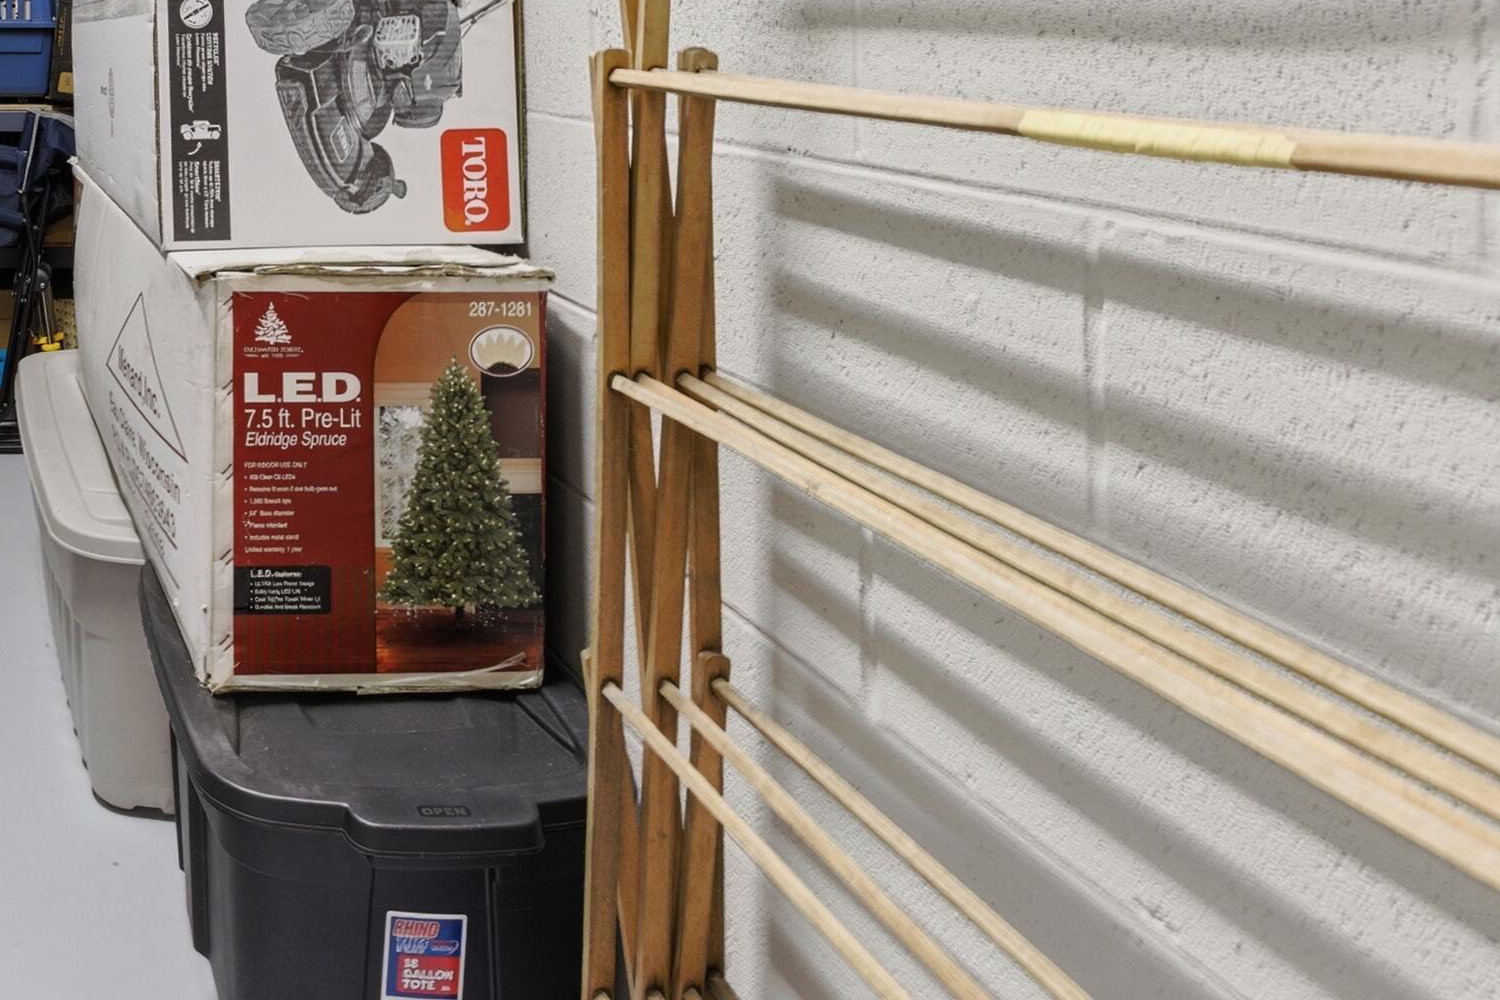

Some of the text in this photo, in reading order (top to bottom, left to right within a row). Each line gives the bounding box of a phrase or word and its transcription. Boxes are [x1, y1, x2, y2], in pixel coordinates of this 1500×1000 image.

[462, 136, 489, 223] TORO
[469, 301, 532, 317] 287-1281
[244, 372, 361, 403] L.E.D.
[244, 408, 361, 428] 7.5 ft. Pre-Lit
[245, 431, 347, 450] Eldridge Spruce
[421, 807, 467, 816] OPEN
[394, 920, 438, 937] RHINO
[403, 969, 454, 980] GALLON
[402, 979, 436, 990] TOTE
